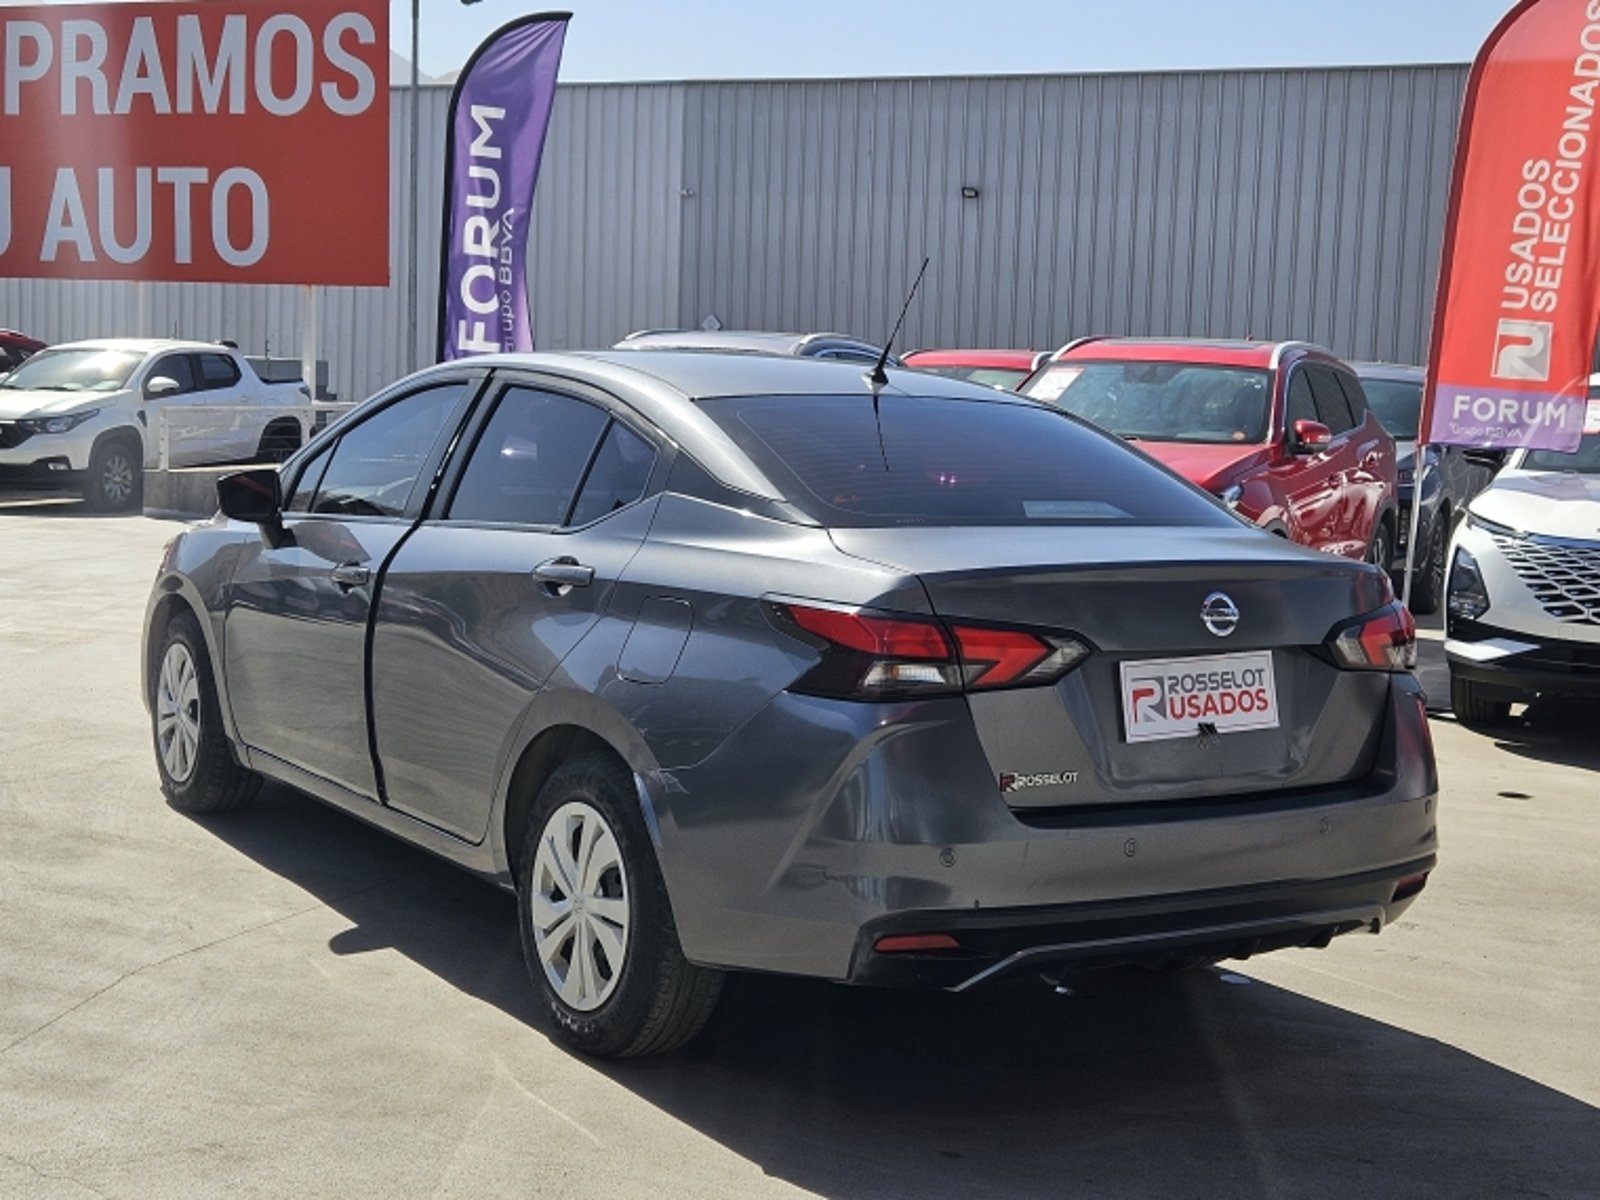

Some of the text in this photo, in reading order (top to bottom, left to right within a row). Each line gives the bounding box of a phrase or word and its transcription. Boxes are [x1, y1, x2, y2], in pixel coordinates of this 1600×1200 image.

[5, 12, 376, 116] PRAMOS
[40, 166, 270, 267] AUTO
[457, 104, 506, 353] FORUM
[1501, 159, 1551, 309] USADOS
[1452, 394, 1567, 428] FORUM
[1167, 668, 1266, 695] ROSSELOT
[1169, 688, 1269, 720] USADOS
